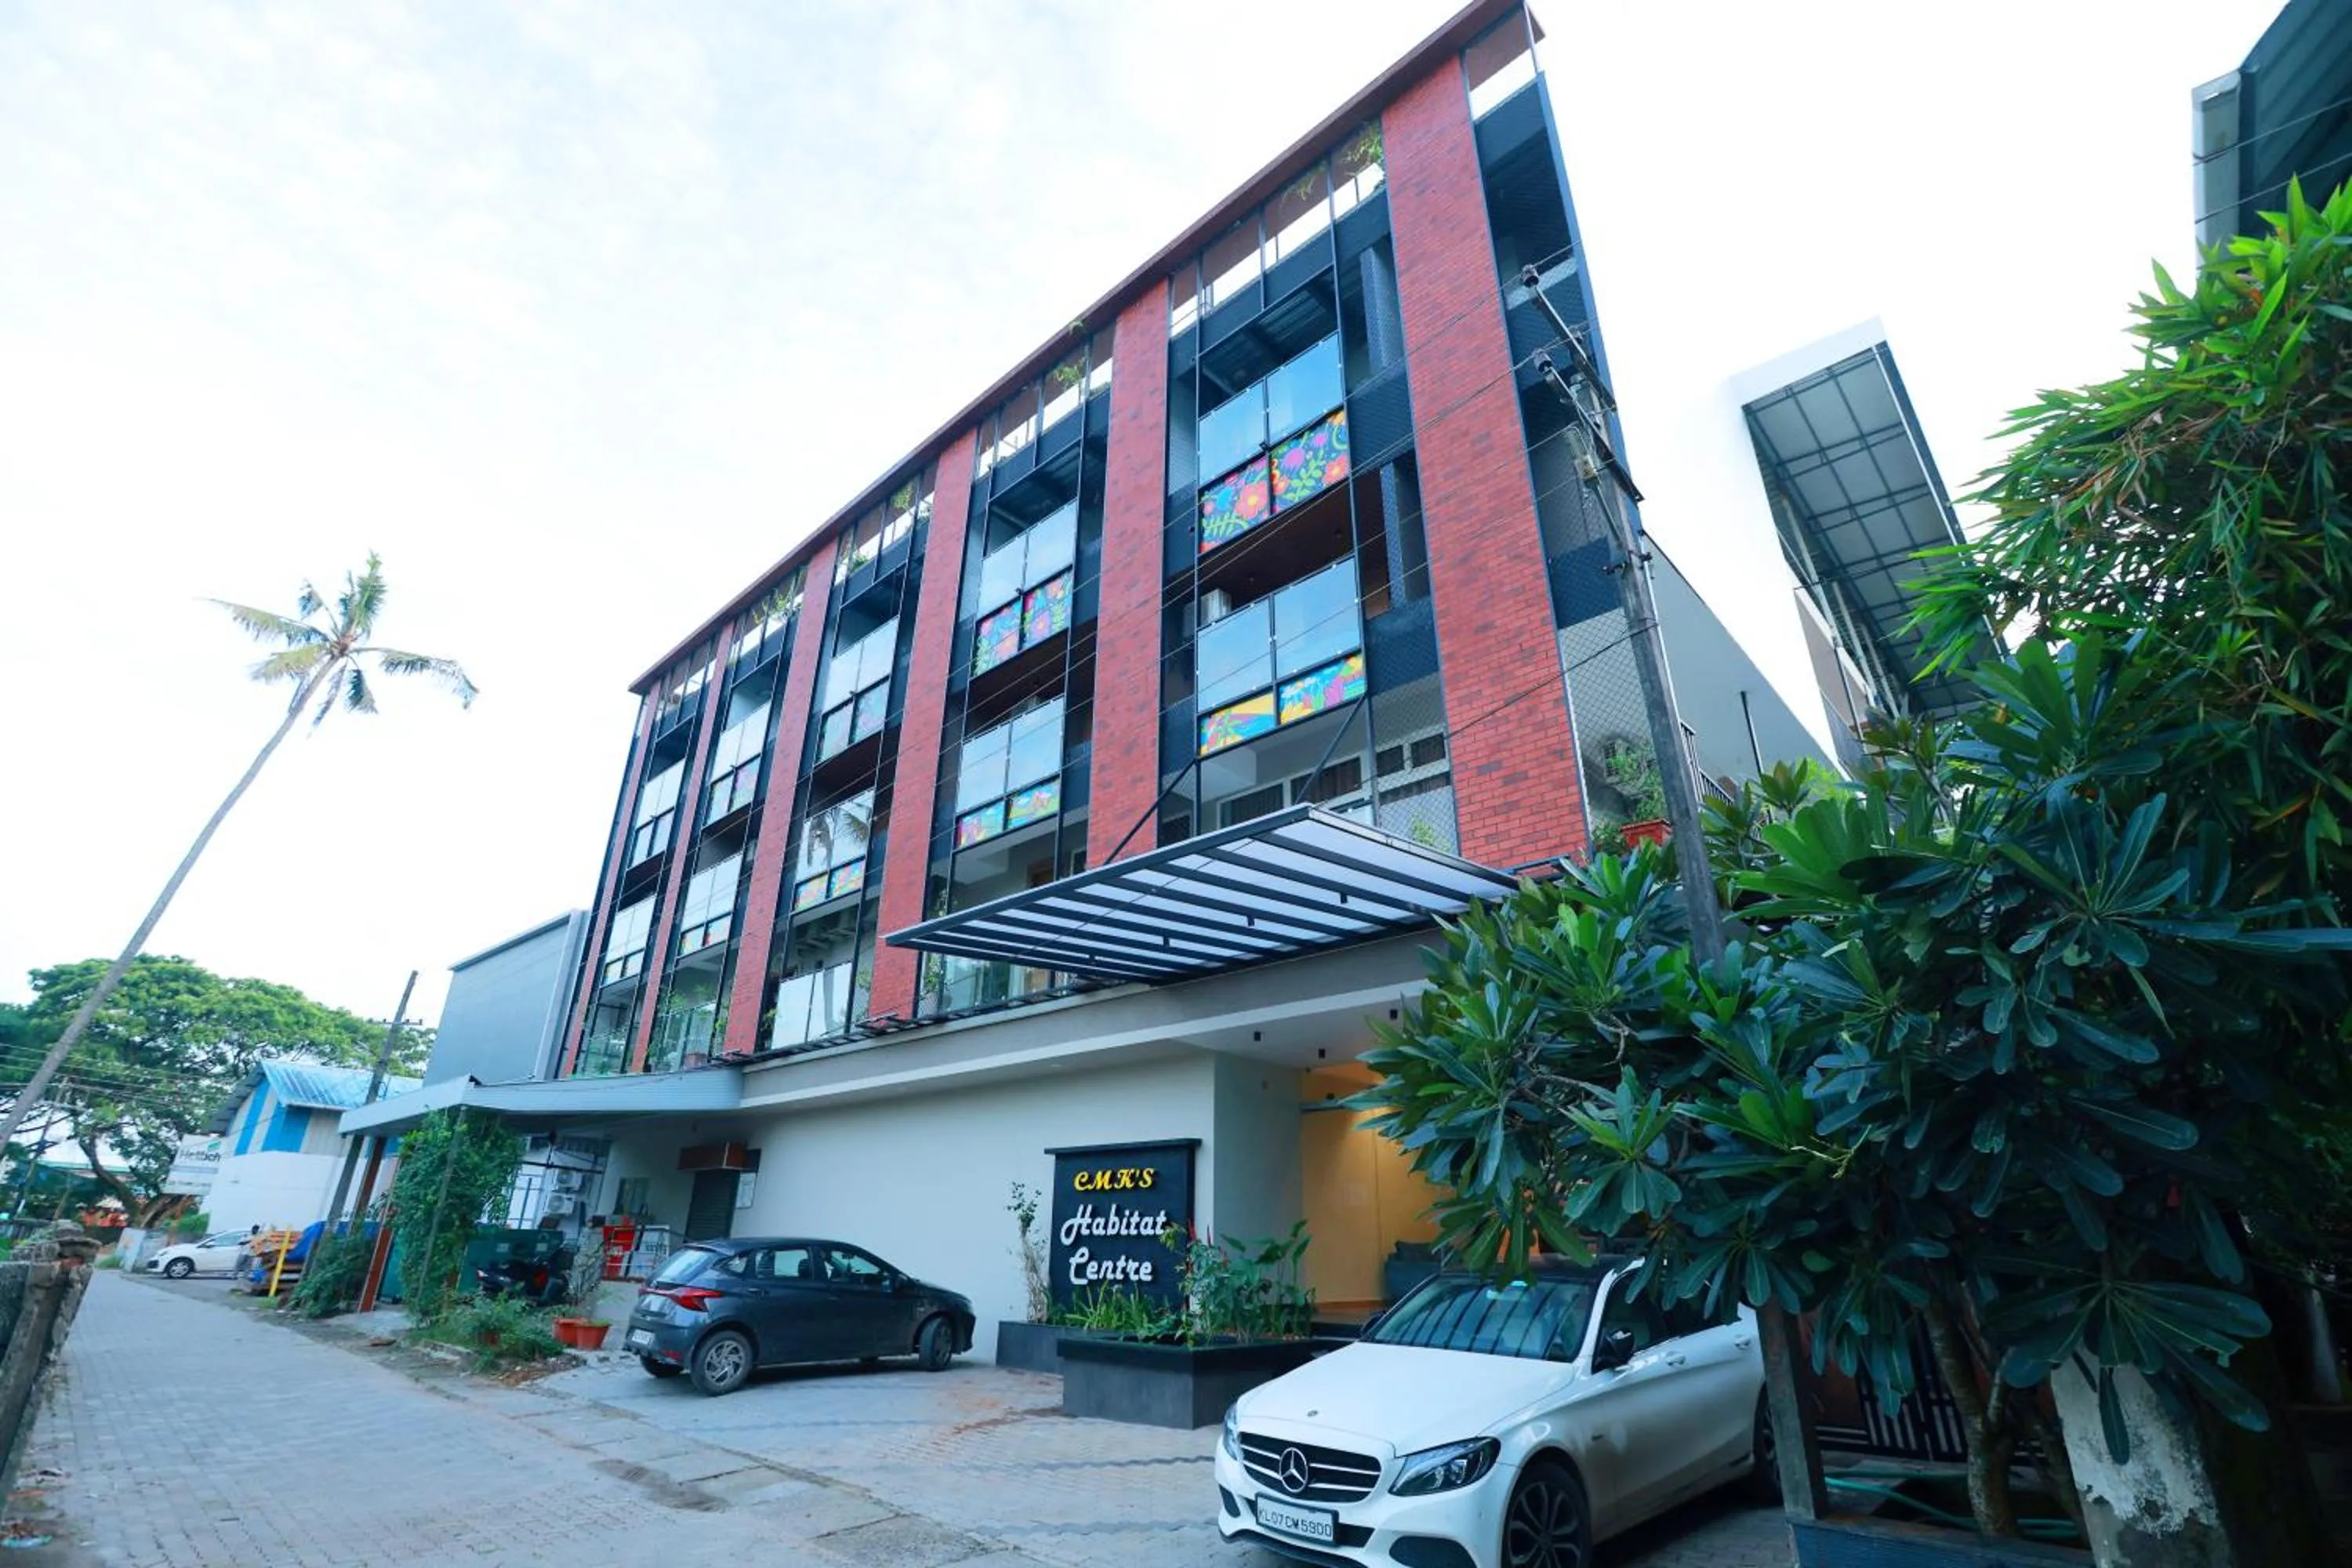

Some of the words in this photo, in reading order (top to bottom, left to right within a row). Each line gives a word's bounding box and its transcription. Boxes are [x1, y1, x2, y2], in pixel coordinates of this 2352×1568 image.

[1074, 1167, 1155, 1191] CMK'S
[1060, 1203, 1167, 1246] Habitat
[1069, 1246, 1153, 1285] Centre
